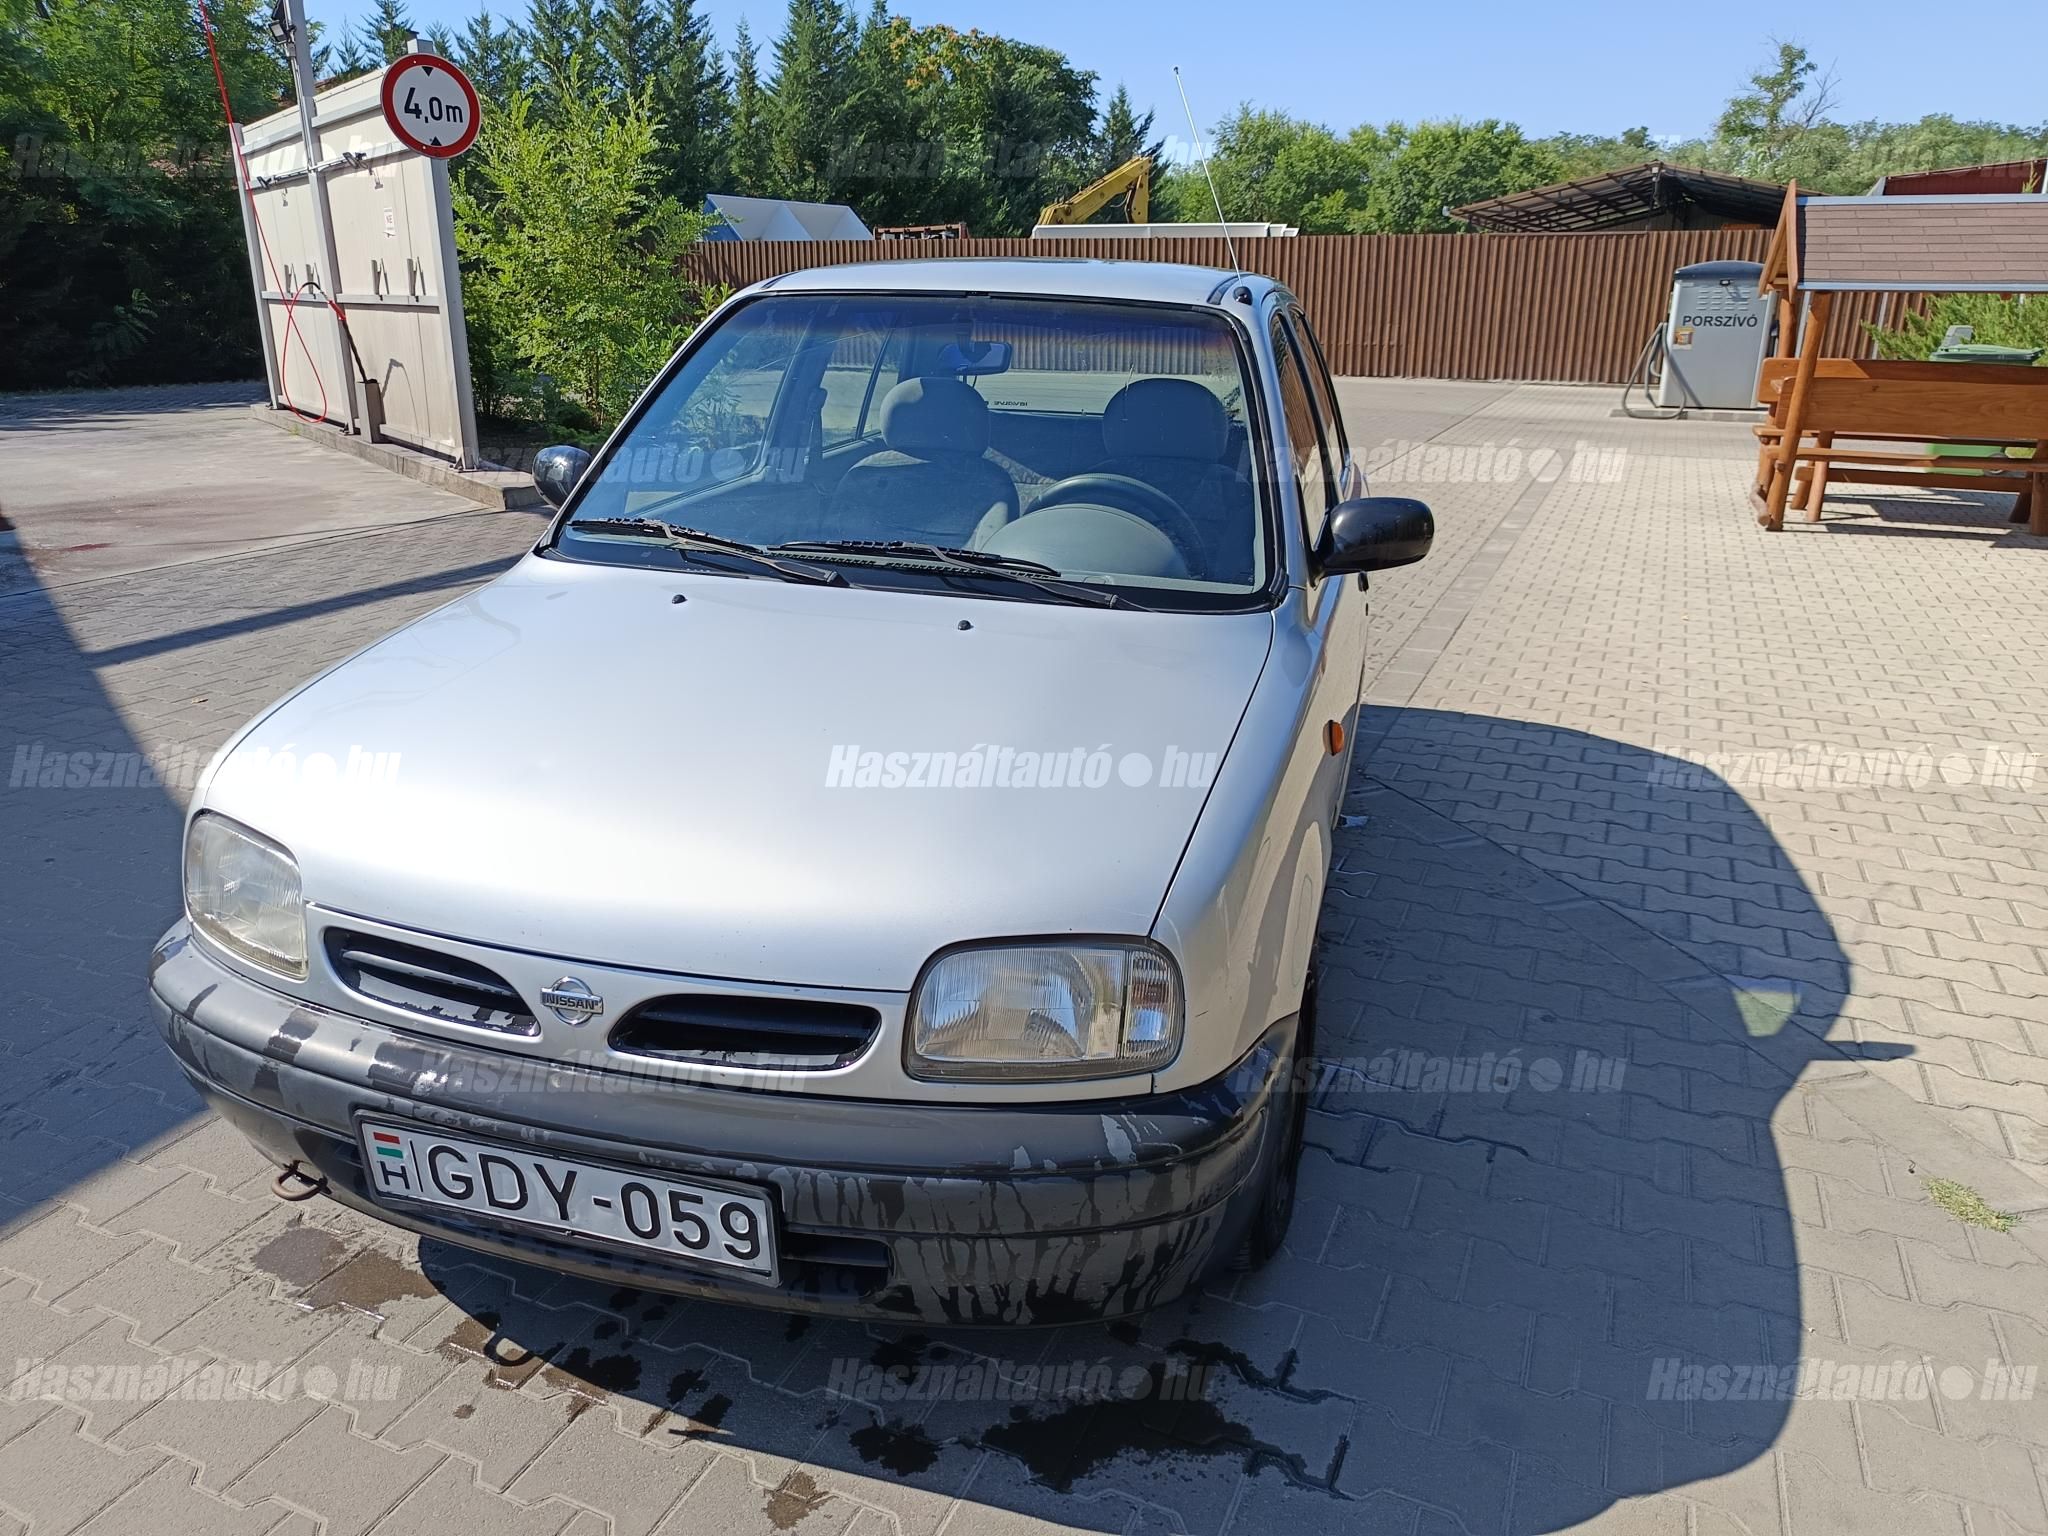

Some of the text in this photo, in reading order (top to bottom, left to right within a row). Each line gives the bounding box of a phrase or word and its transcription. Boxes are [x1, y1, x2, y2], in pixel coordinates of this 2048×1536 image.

[1682, 313, 1758, 328] PORSZÍVÓ
[546, 992, 595, 1010] NISSAN
[427, 1144, 762, 1261] GDY-059
